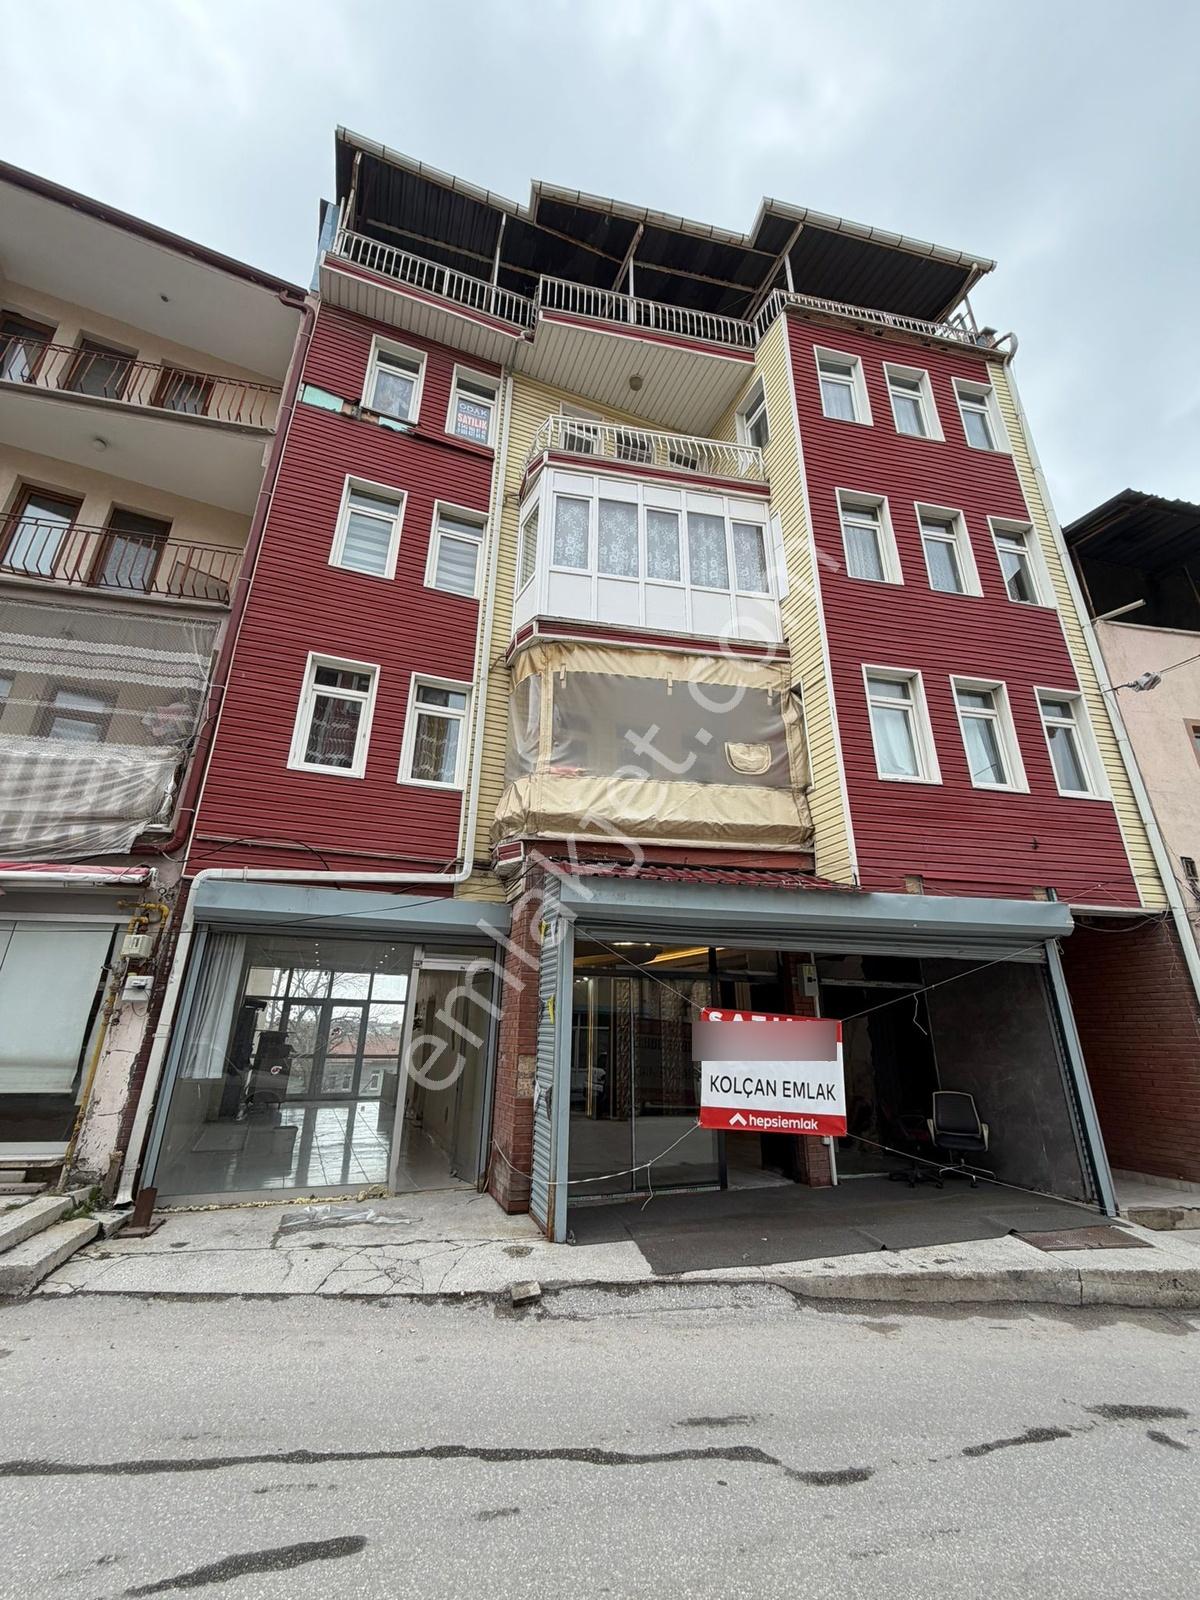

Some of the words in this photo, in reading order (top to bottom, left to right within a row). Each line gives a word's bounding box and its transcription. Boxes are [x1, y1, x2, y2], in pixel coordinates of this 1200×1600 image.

[460, 403, 487, 416] ODAK
[457, 413, 488, 430] SATILIK
[710, 1074, 777, 1099] KOLÇAN
[782, 1080, 836, 1101] EMLAK
[749, 1114, 818, 1131] hepsiemlak
